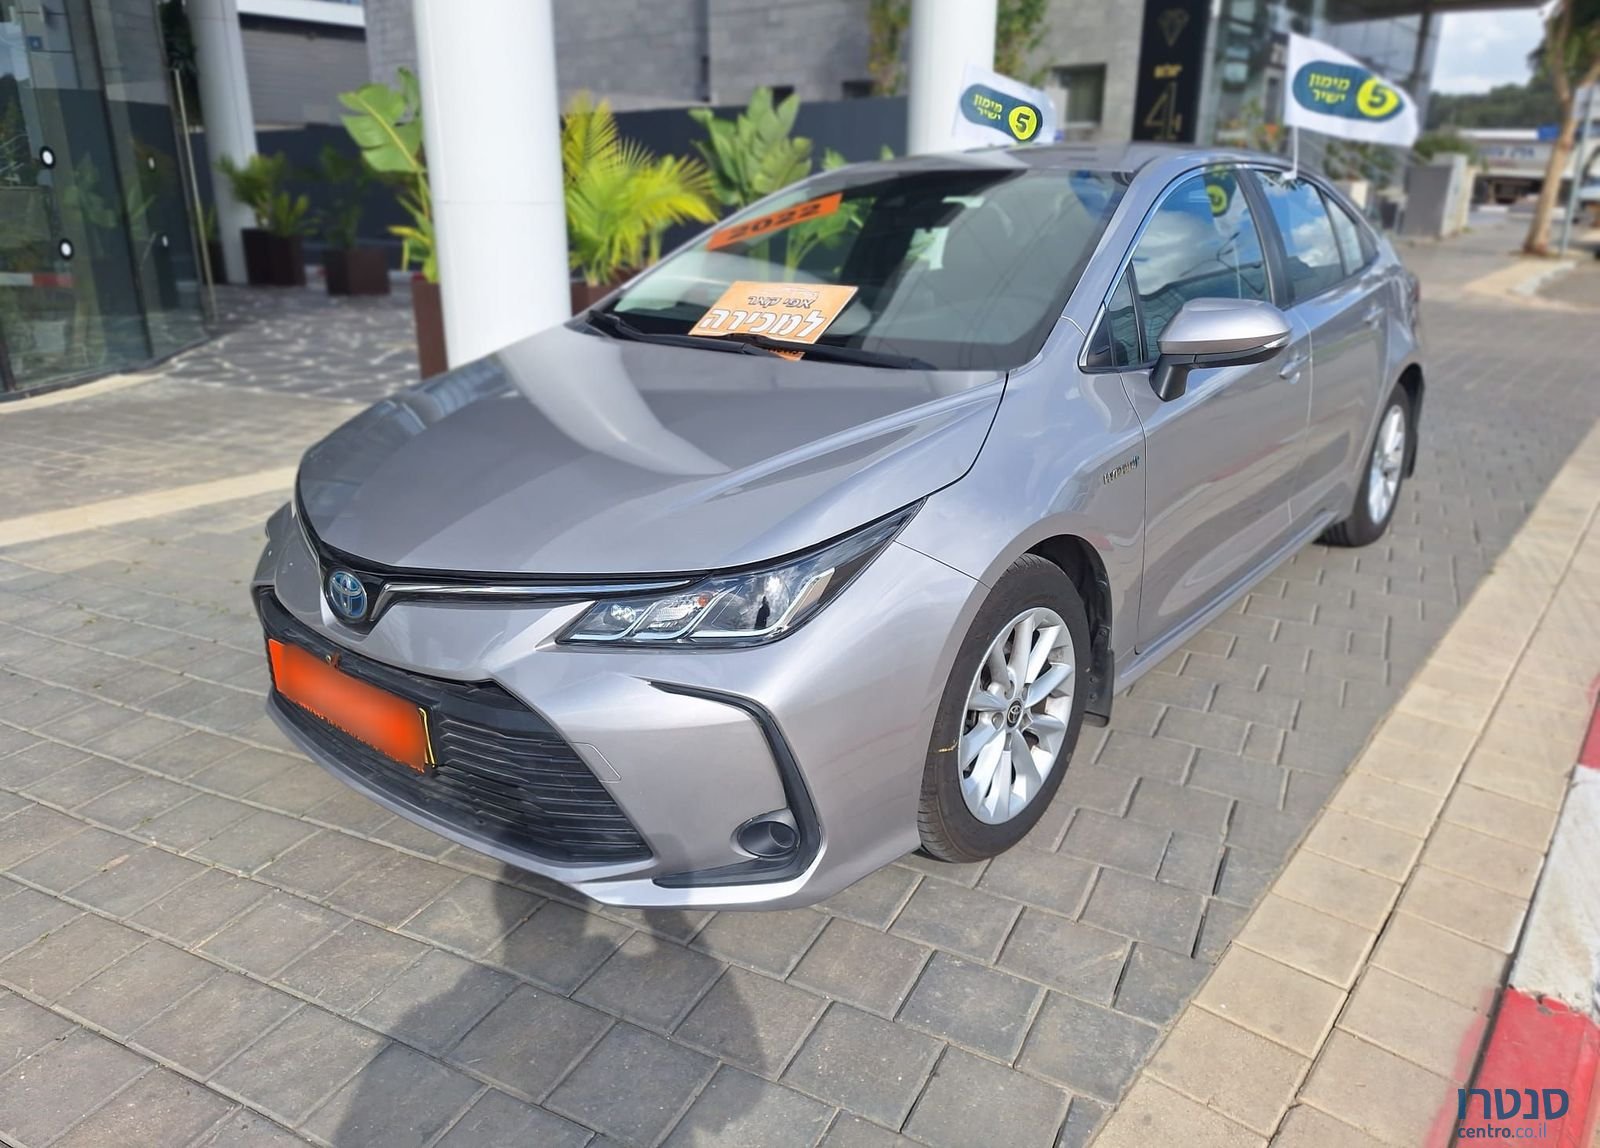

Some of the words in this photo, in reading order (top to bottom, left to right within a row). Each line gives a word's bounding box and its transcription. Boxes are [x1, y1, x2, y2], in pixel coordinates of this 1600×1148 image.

[1309, 73, 1351, 90] מימון
[973, 94, 1003, 113] מימון
[1312, 88, 1346, 104] ישיר
[1016, 112, 1031, 133] 5
[728, 202, 822, 239] 2022
[783, 297, 816, 309] אפי
[700, 309, 826, 338] למכירה
